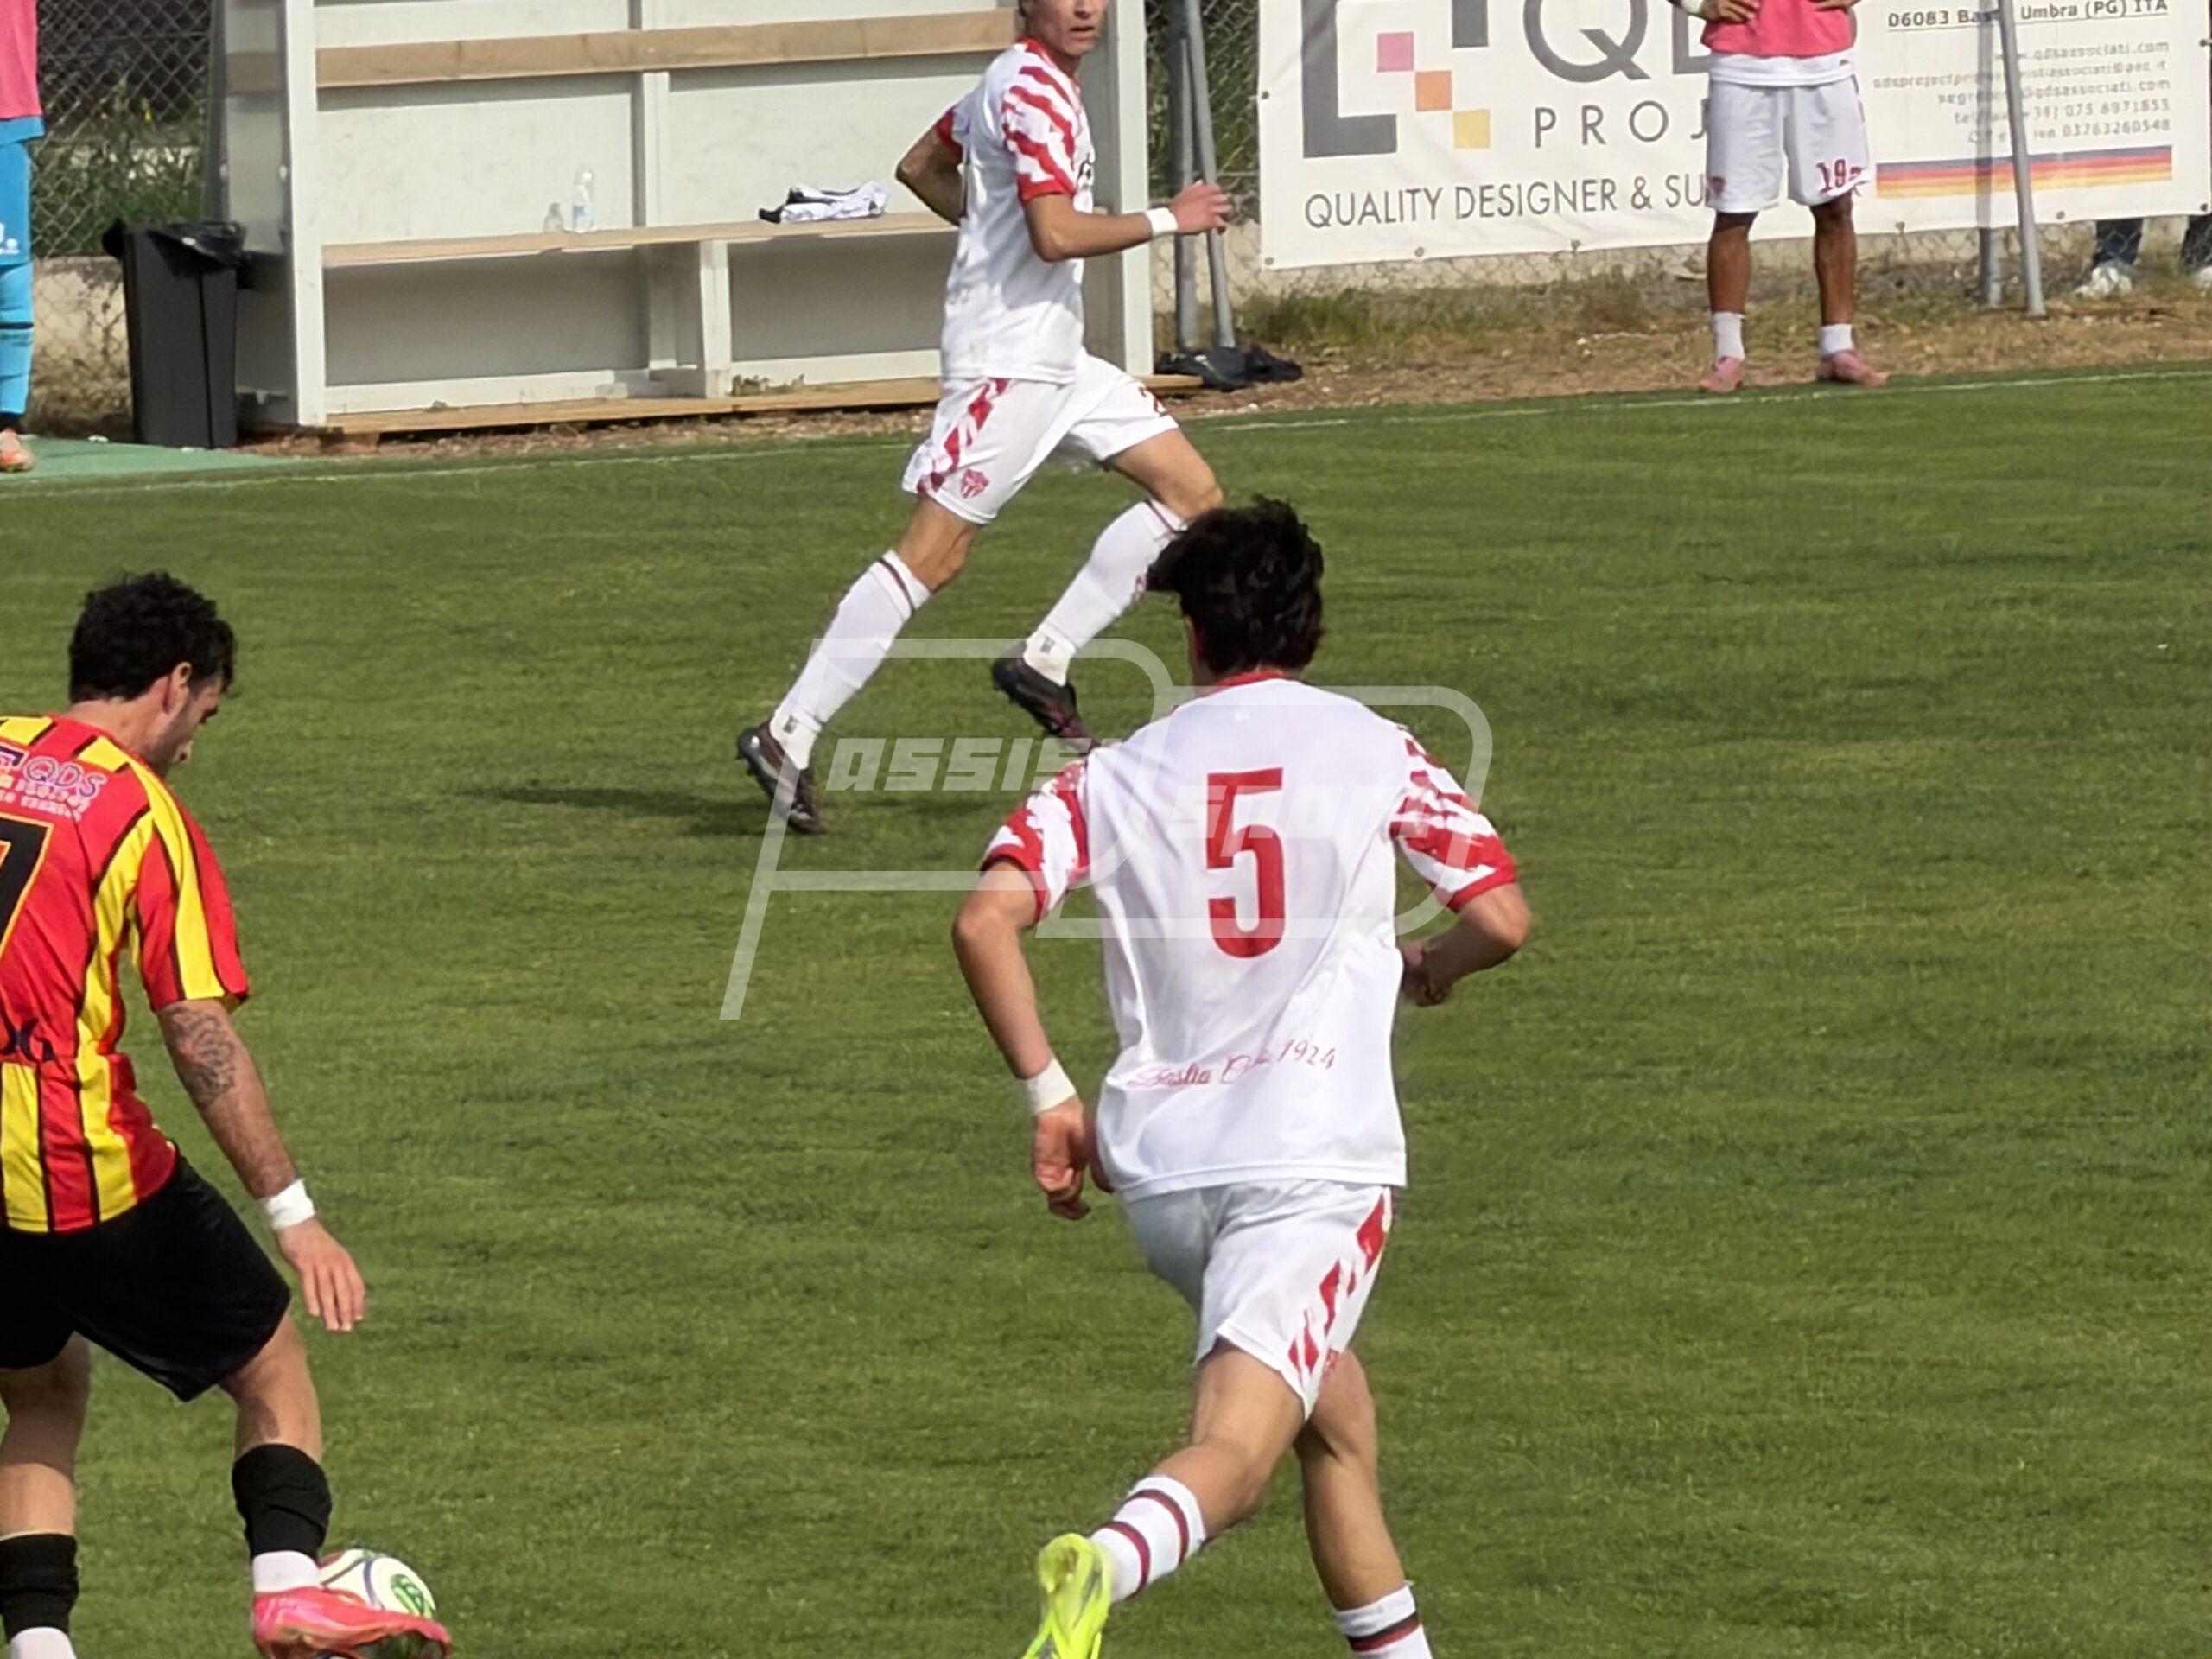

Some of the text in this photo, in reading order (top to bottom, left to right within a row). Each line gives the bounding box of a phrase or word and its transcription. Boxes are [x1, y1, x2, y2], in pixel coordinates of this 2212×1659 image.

[1888, 10, 1949, 27] 06083
[2021, 4, 2078, 19] Umbra
[2085, 0, 2126, 19] (PG)
[2134, 0, 2168, 12] ITA
[1305, 187, 1444, 229] QUALITY
[1455, 178, 1618, 220] DESIGNER
[1630, 176, 1652, 210] &
[23, 755, 107, 798] QDS
[1206, 766, 1286, 959] 5
[1278, 1039, 1337, 1070] 1924
